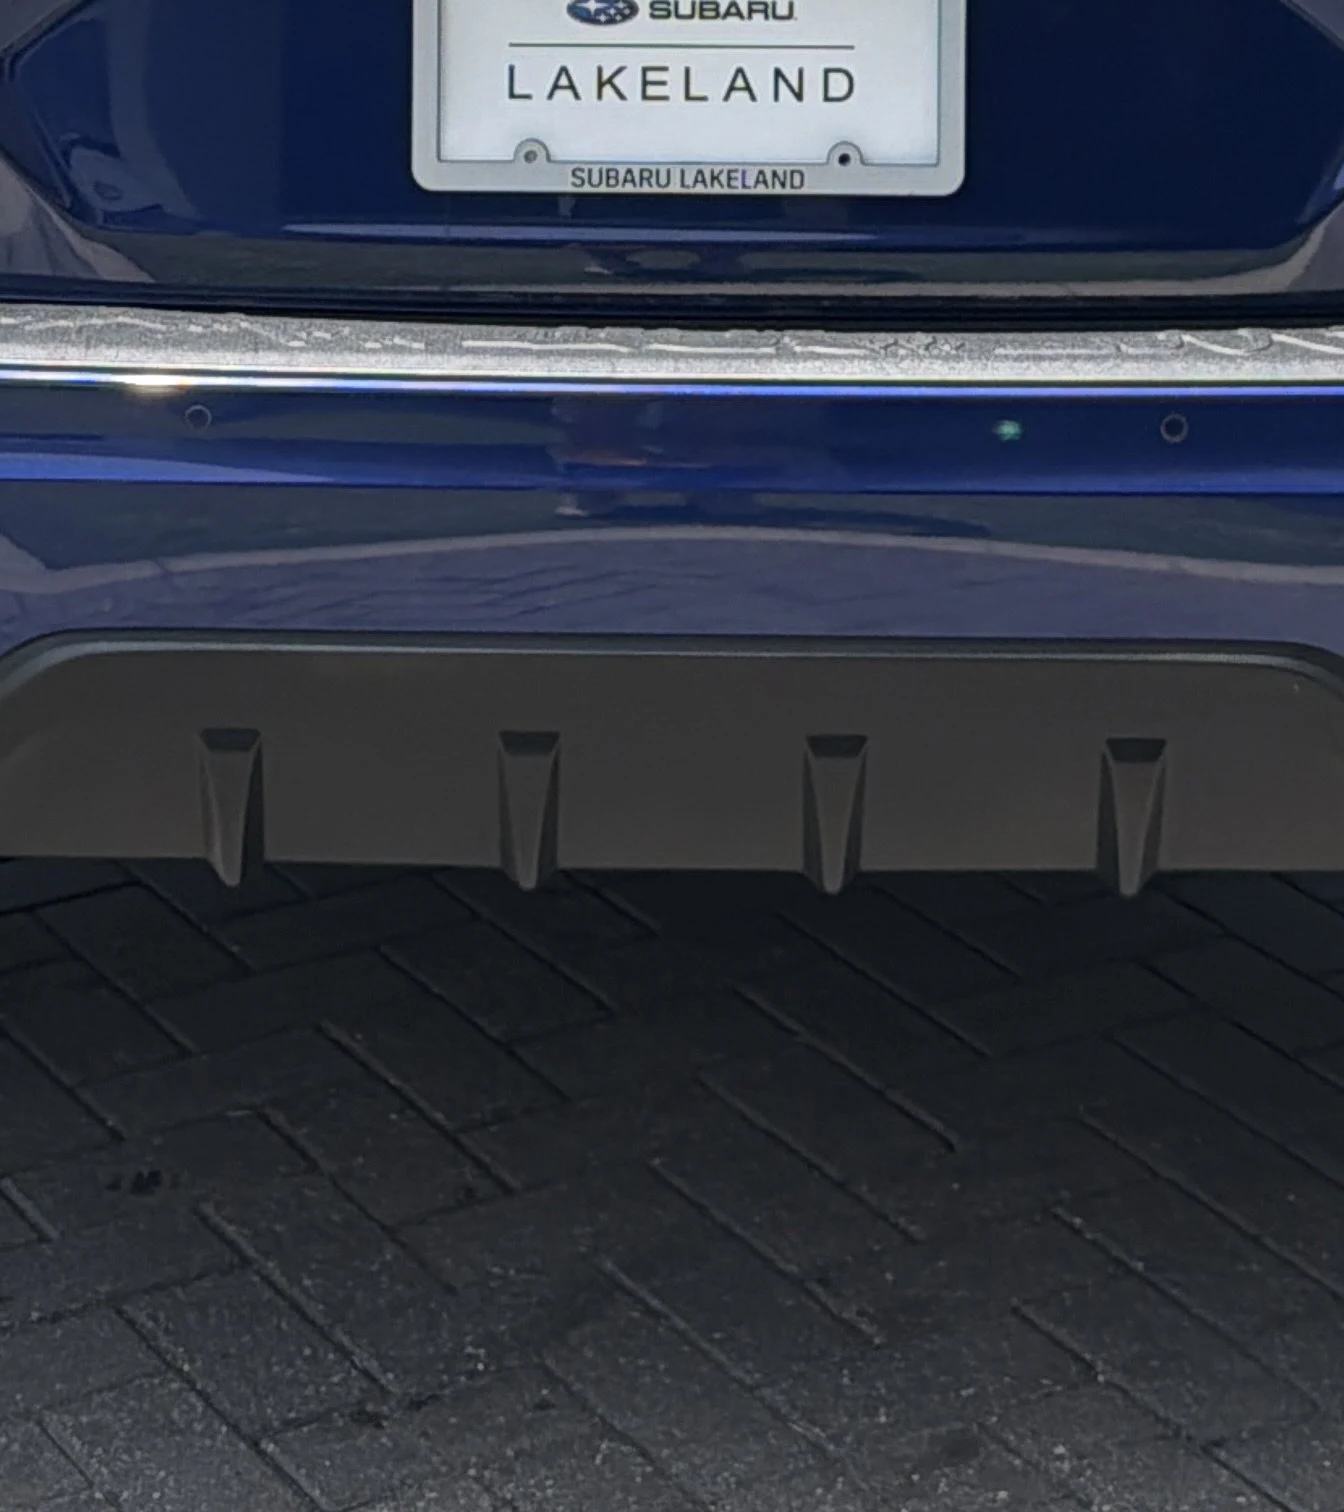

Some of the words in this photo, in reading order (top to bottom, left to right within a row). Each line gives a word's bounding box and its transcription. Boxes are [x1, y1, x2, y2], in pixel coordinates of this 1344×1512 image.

[507, 64, 855, 103] LAKELAND
[570, 167, 672, 189] SUBARU
[679, 169, 805, 190] LAKELAND
